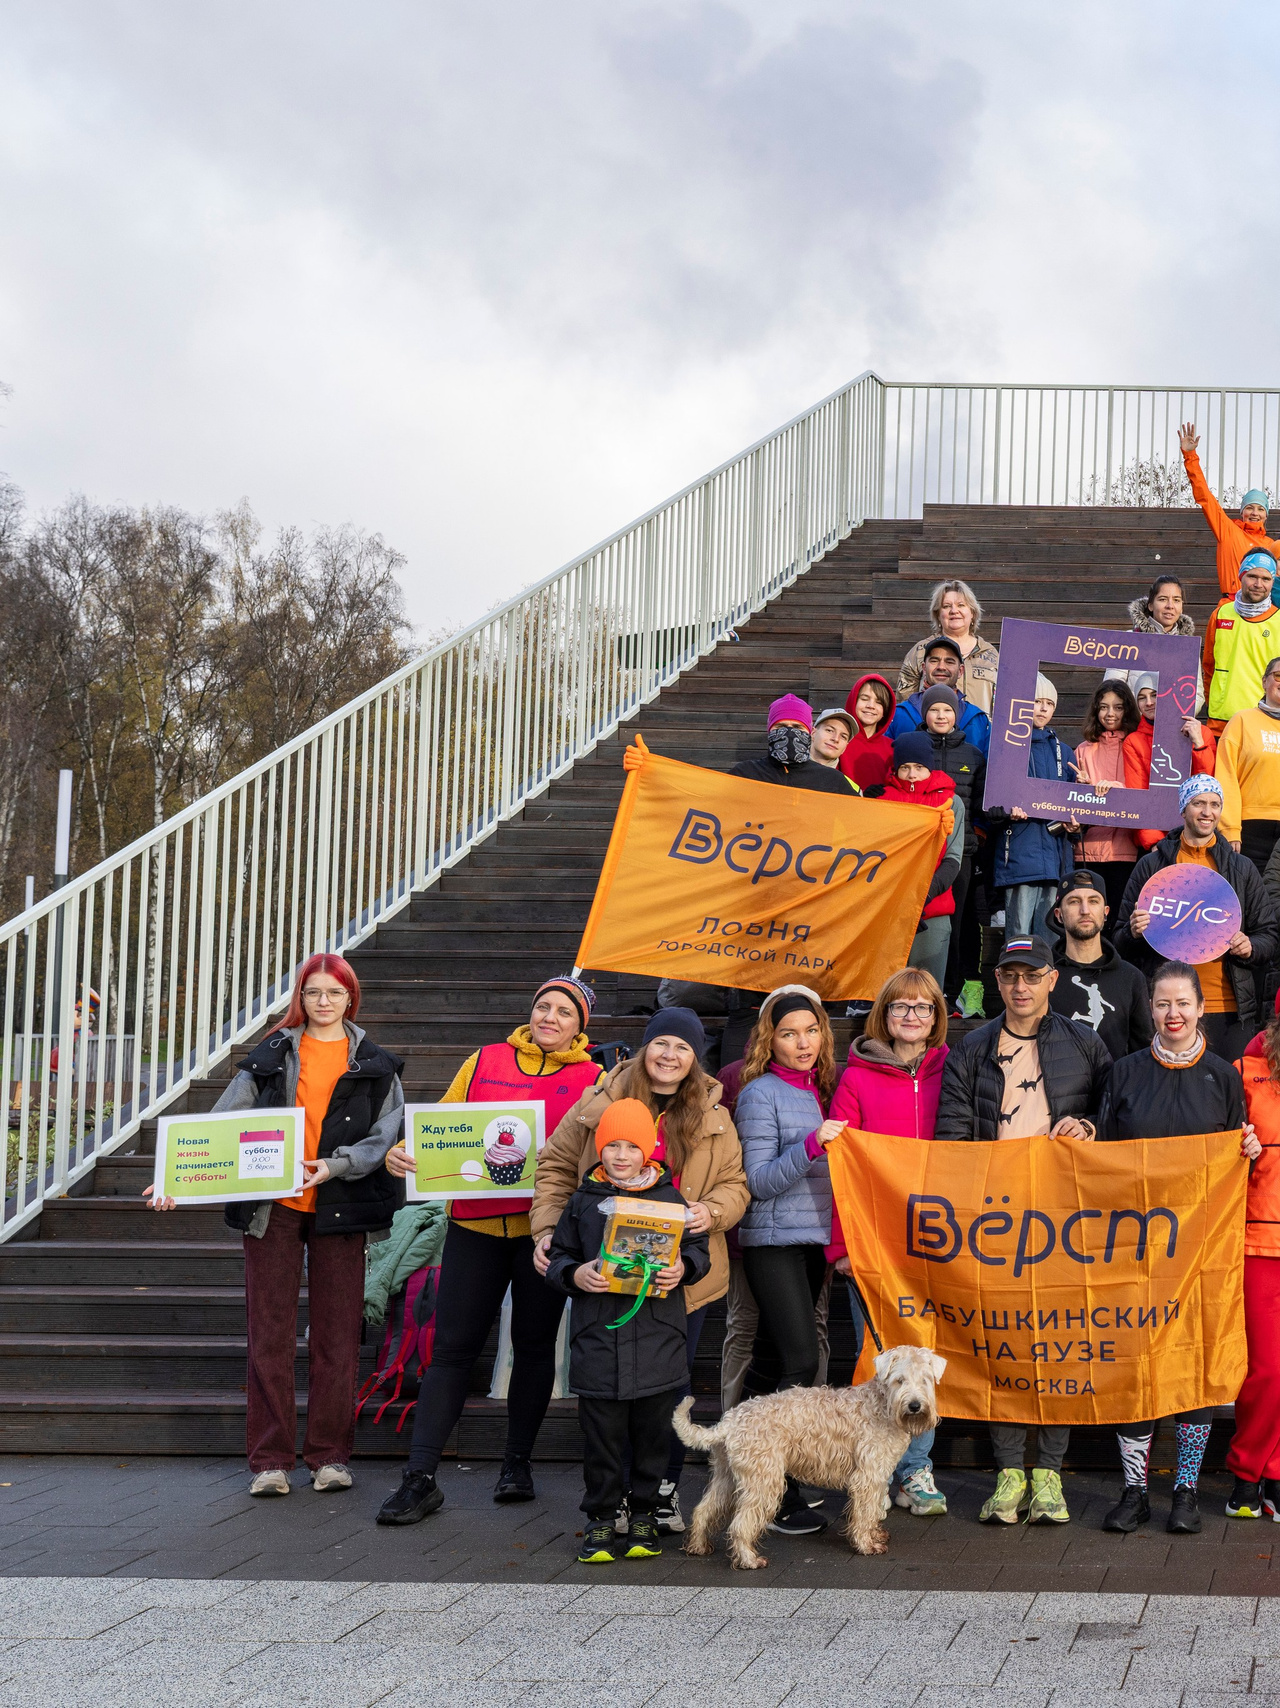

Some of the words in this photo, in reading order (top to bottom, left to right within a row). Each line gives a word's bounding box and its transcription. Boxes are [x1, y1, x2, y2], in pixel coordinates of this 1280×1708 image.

[1067, 791, 1106, 804] Лобня
[697, 917, 811, 942] ЛОБНЯ
[657, 940, 776, 962] ГОРОДСКОЙ
[784, 953, 837, 971] ПАРК
[421, 1125, 446, 1135] Жду
[448, 1124, 473, 1133] тебя
[177, 1138, 210, 1146] Новая
[436, 1139, 484, 1150] финише!
[244, 1147, 279, 1155] суббота
[175, 1160, 234, 1170] начинается
[182, 1173, 227, 1184] субботы
[898, 1296, 1180, 1331] БАБУШКИНСКИЙ
[973, 1339, 1017, 1361] НА
[1031, 1341, 1116, 1363] ЯУЗЕ
[995, 1375, 1096, 1395] МОСКВА
